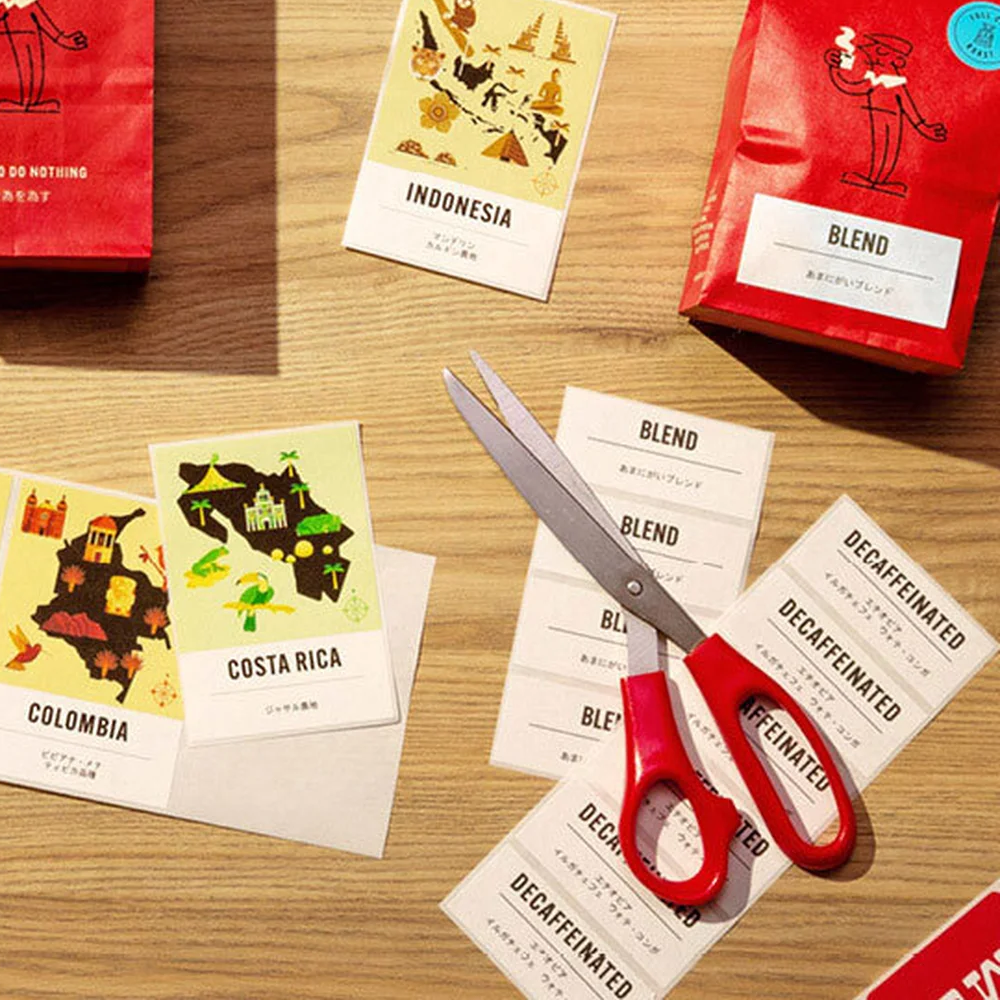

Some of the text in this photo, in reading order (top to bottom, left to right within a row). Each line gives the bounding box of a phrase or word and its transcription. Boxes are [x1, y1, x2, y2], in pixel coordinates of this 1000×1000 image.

[9, 165, 26, 178] DO
[29, 166, 88, 179] NOTHING
[406, 182, 512, 228] INDONESIA
[827, 224, 889, 257] BLEND
[639, 419, 698, 452] BLEND
[620, 515, 680, 547] BLEND
[844, 529, 967, 651] DECAFFEINATED
[227, 647, 342, 680] COSTA RICA
[778, 598, 902, 722] DECAFFEINATED
[27, 701, 128, 742] COLOMBIA
[581, 706, 622, 733] BLE
[739, 695, 831, 792] AFFEINATED
[510, 872, 633, 1000] DECAFFEINATED
